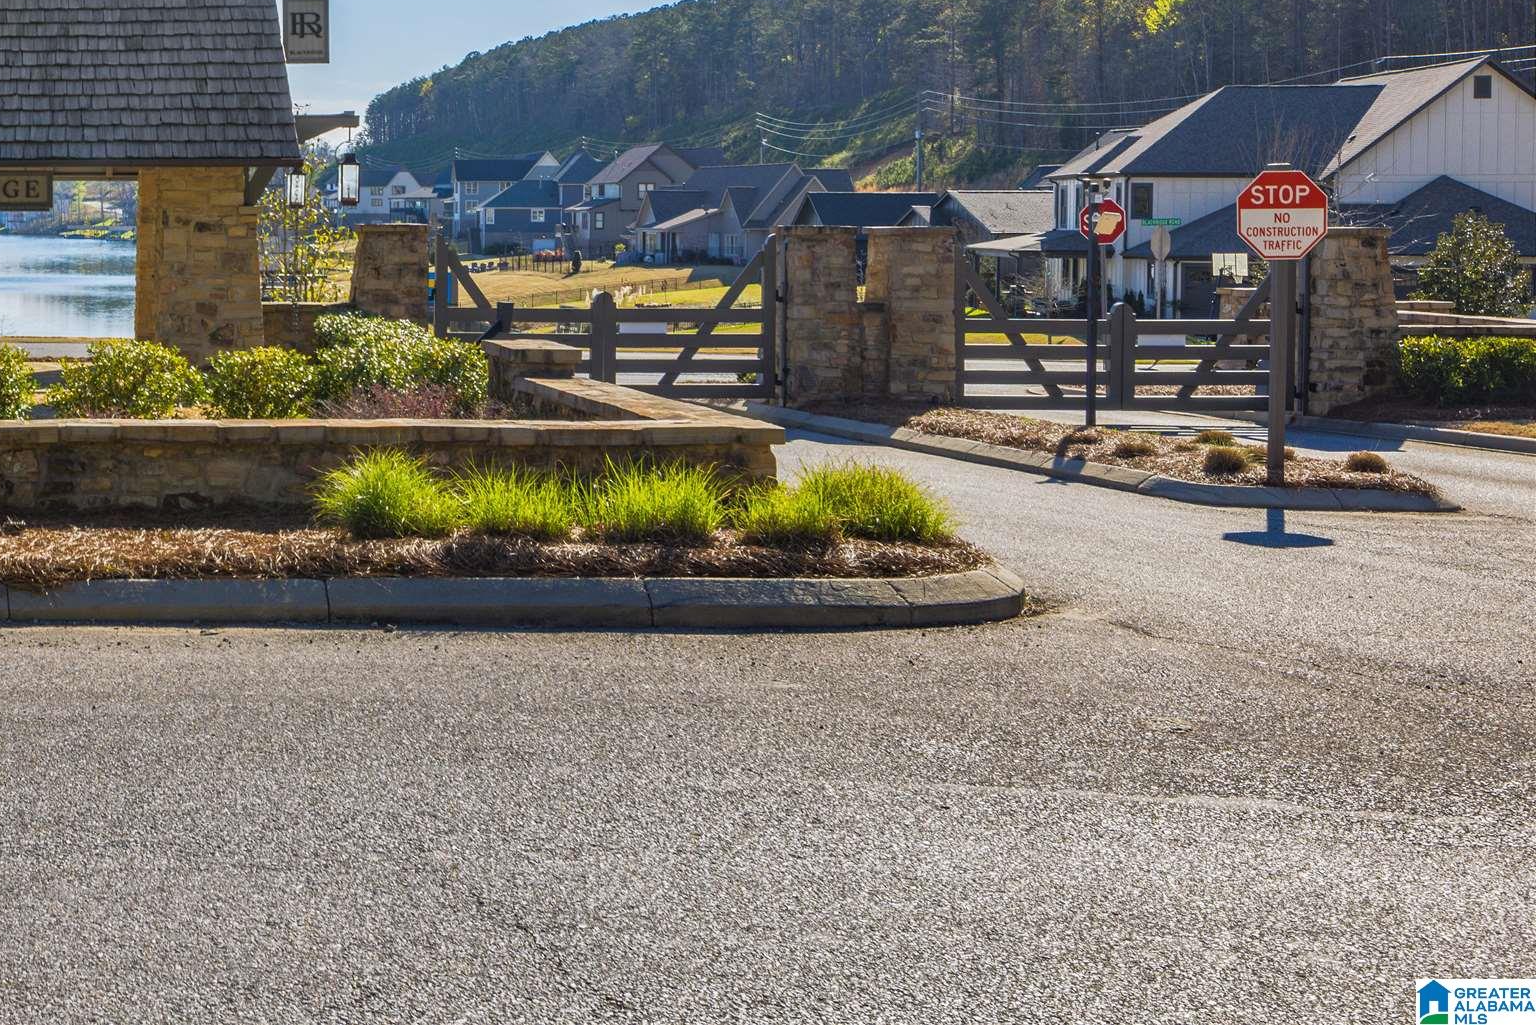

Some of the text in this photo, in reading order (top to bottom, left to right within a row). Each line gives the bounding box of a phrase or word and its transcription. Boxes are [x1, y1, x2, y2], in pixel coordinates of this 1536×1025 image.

[1250, 184, 1311, 205] STOP
[1273, 212, 1291, 223] NO
[1246, 226, 1319, 238] CONSTRUCTION
[1263, 239, 1303, 252] TRAFFIC
